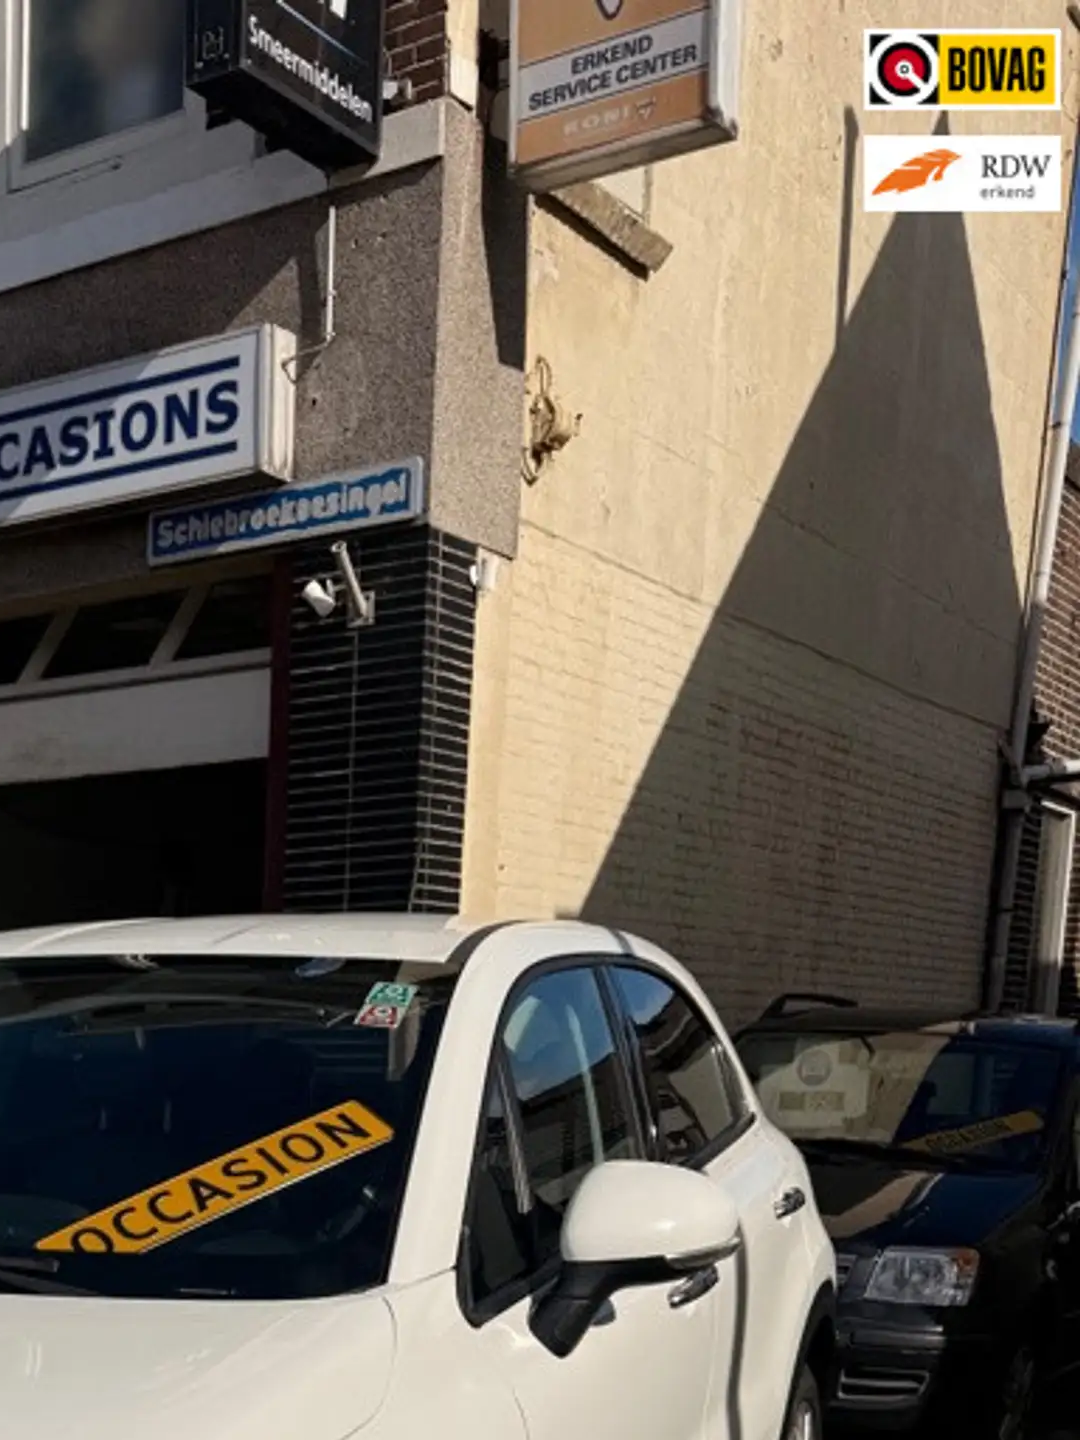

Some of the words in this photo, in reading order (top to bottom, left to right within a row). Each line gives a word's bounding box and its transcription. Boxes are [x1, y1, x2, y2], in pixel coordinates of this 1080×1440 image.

[248, 14, 373, 122] Smeermiddelen
[528, 71, 612, 111] SERVICE
[615, 44, 697, 83] CENTER
[571, 34, 653, 75] ERKEND
[70, 1112, 373, 1254] OCCASION
